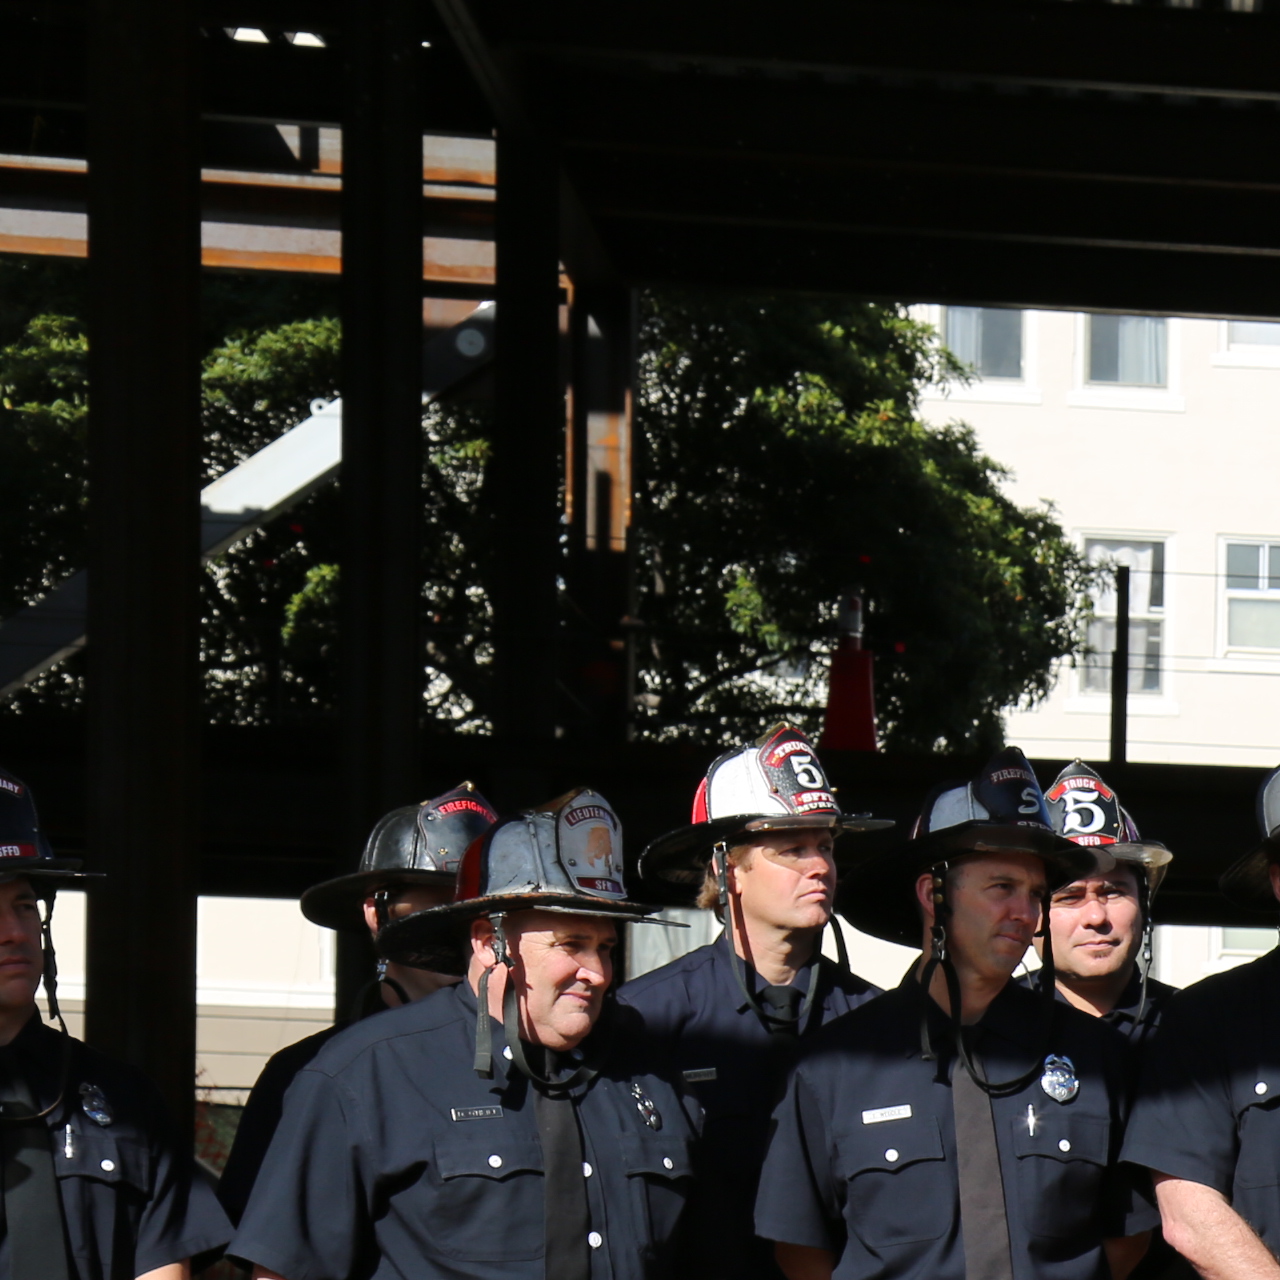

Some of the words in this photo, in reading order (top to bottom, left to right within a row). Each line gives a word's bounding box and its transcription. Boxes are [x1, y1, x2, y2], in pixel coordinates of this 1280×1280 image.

[790, 755, 824, 789] 5
[1064, 778, 1096, 789] TRUCK
[1061, 790, 1105, 834] 5
[1077, 836, 1101, 847] SFFD
